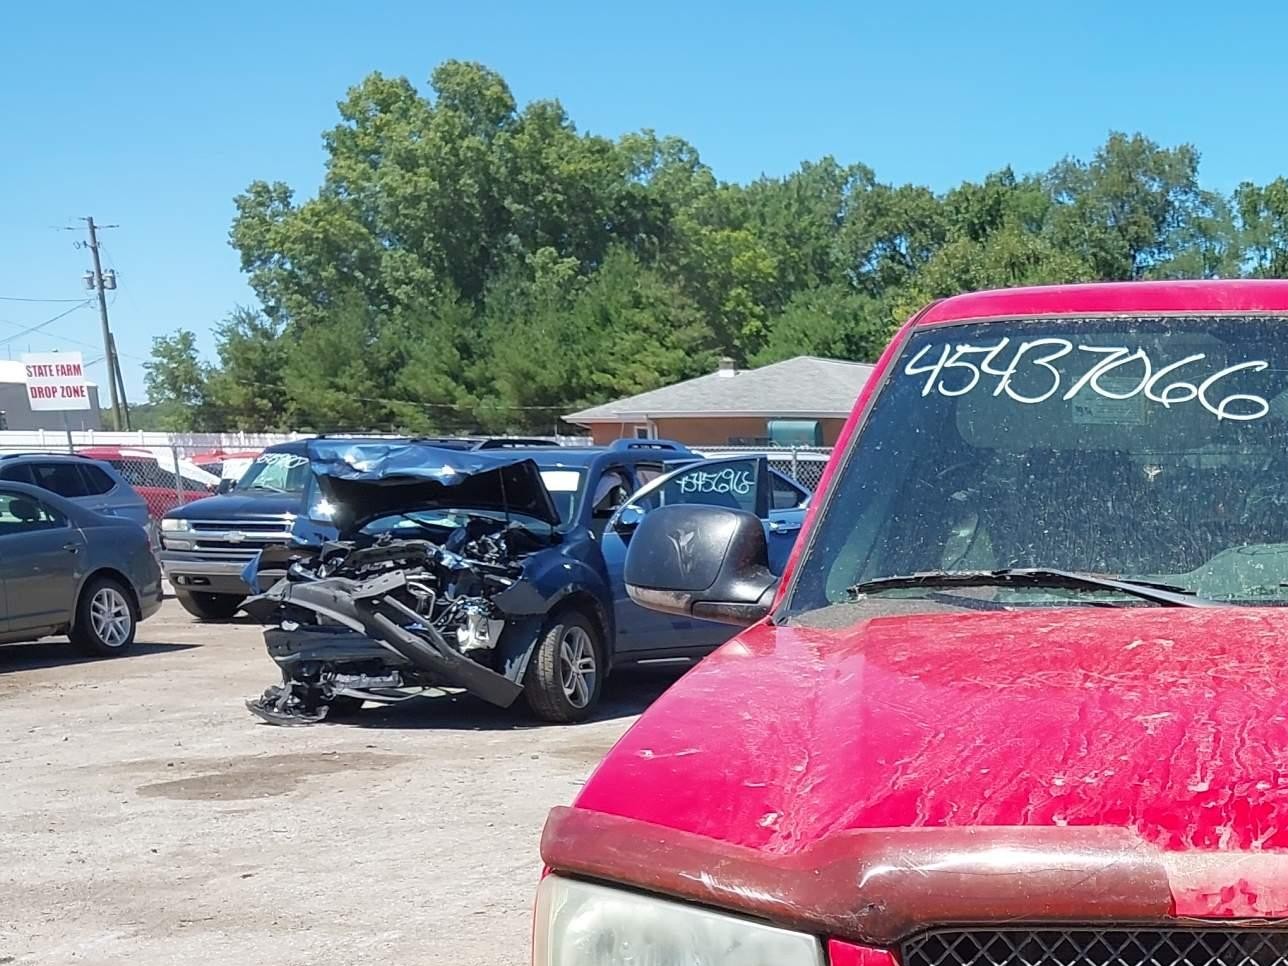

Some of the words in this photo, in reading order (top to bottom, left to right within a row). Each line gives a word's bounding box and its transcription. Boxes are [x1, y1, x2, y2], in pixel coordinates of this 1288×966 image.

[25, 364, 54, 377] STATE
[56, 363, 82, 376] FARM
[905, 336, 1270, 421] 45437066
[30, 385, 58, 398] DROP
[60, 385, 86, 398] ZONE
